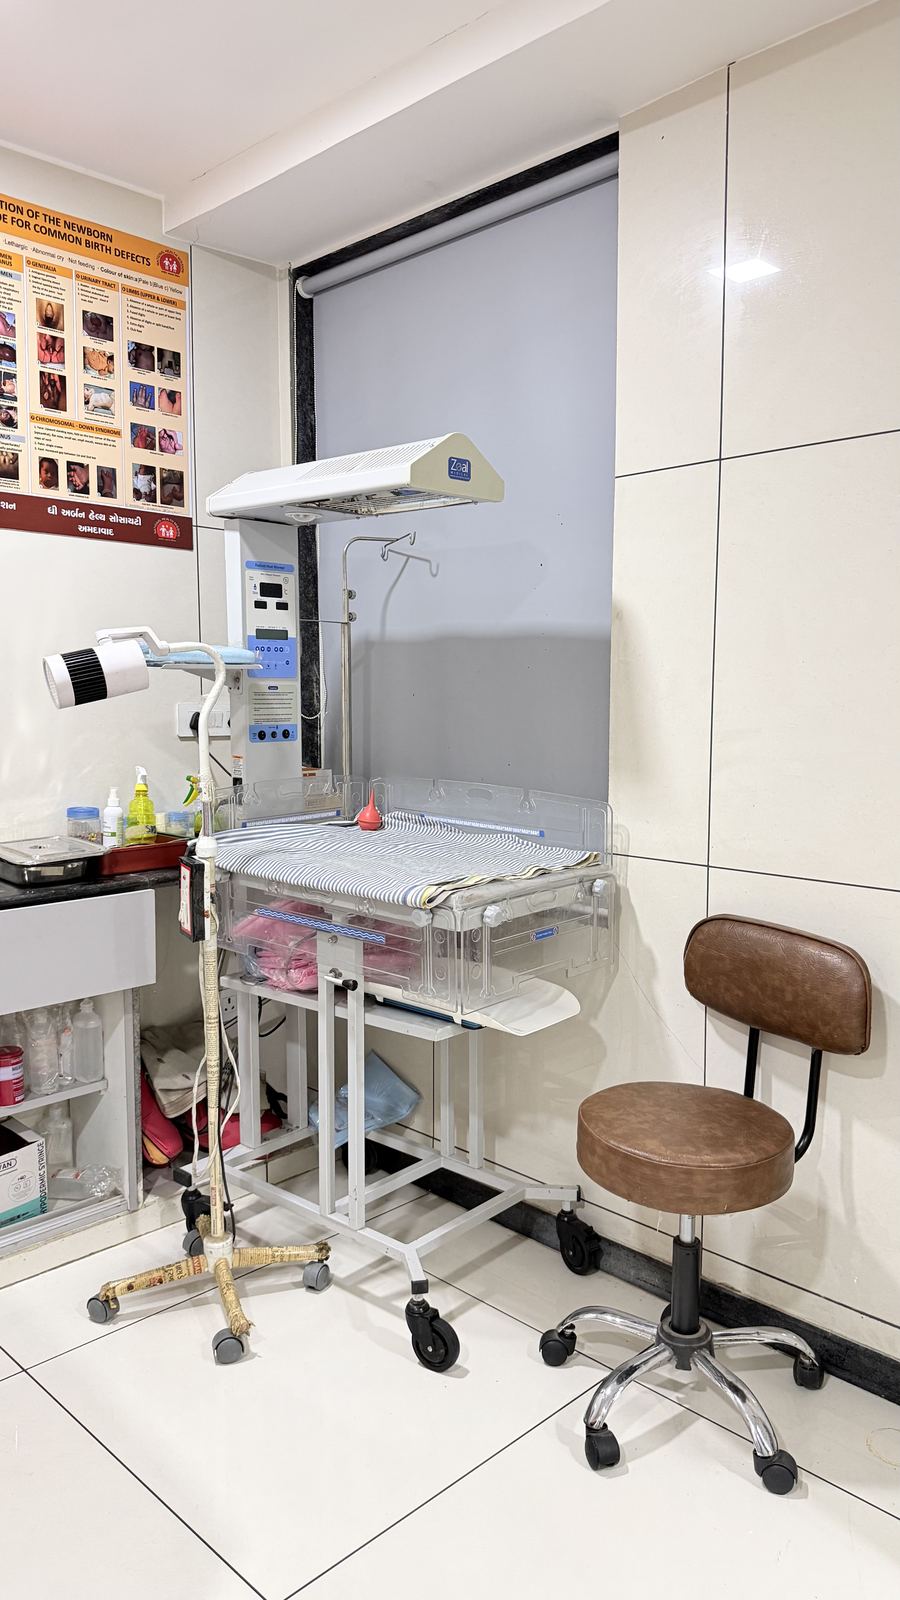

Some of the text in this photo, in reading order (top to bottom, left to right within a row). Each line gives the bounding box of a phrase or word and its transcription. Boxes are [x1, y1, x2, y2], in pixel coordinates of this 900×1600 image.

[0, 200, 113, 243] TION OF THE NEWBORN
[11, 216, 31, 231] FOR
[33, 224, 82, 245] COMMON
[85, 239, 112, 255] BIRTH
[114, 247, 151, 267] DEFECTS
[100, 266, 117, 276] Colour
[35, 415, 75, 428] CHROMOSOMAL
[78, 423, 95, 431] DOWN
[95, 426, 121, 436] SYNDROME
[109, 512, 142, 526] સોસાયટી
[77, 524, 115, 536] અમદાવાદ
[37, 1141, 48, 1214] HYPODERMIC SYRINGE
